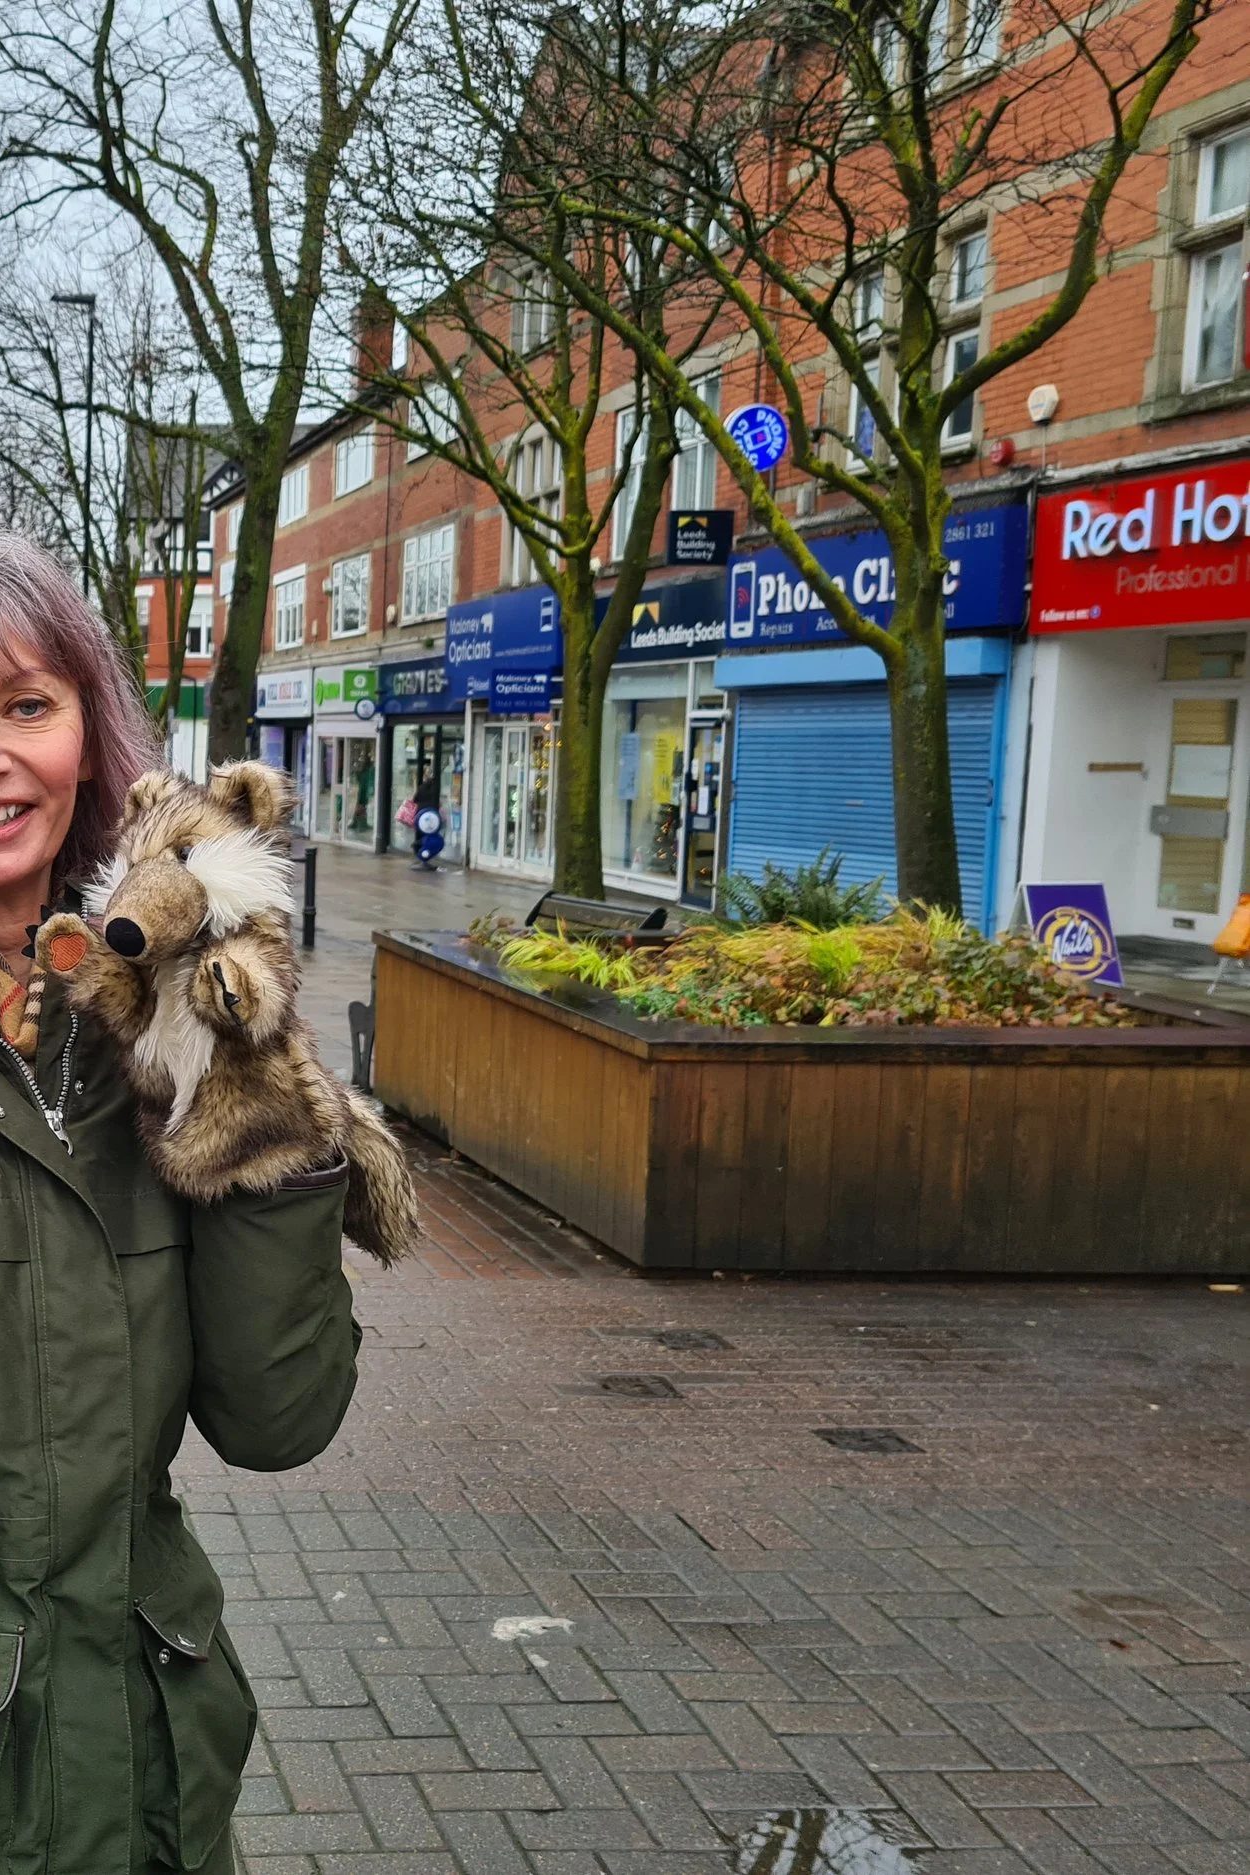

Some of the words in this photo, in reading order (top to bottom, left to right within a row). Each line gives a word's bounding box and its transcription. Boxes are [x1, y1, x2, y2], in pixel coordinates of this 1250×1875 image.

[756, 409, 783, 460] PHONE
[676, 530, 707, 539] Leeds
[1061, 488, 1156, 561] Red
[676, 540, 716, 551] Building
[676, 550, 713, 561] Society
[1116, 555, 1239, 595] Professional
[631, 628, 657, 648] Leeds
[657, 623, 694, 648] Building
[695, 620, 727, 641] Societ
[760, 622, 794, 639] Repairs
[448, 638, 491, 667] Opticians
[495, 683, 546, 695] Opticians
